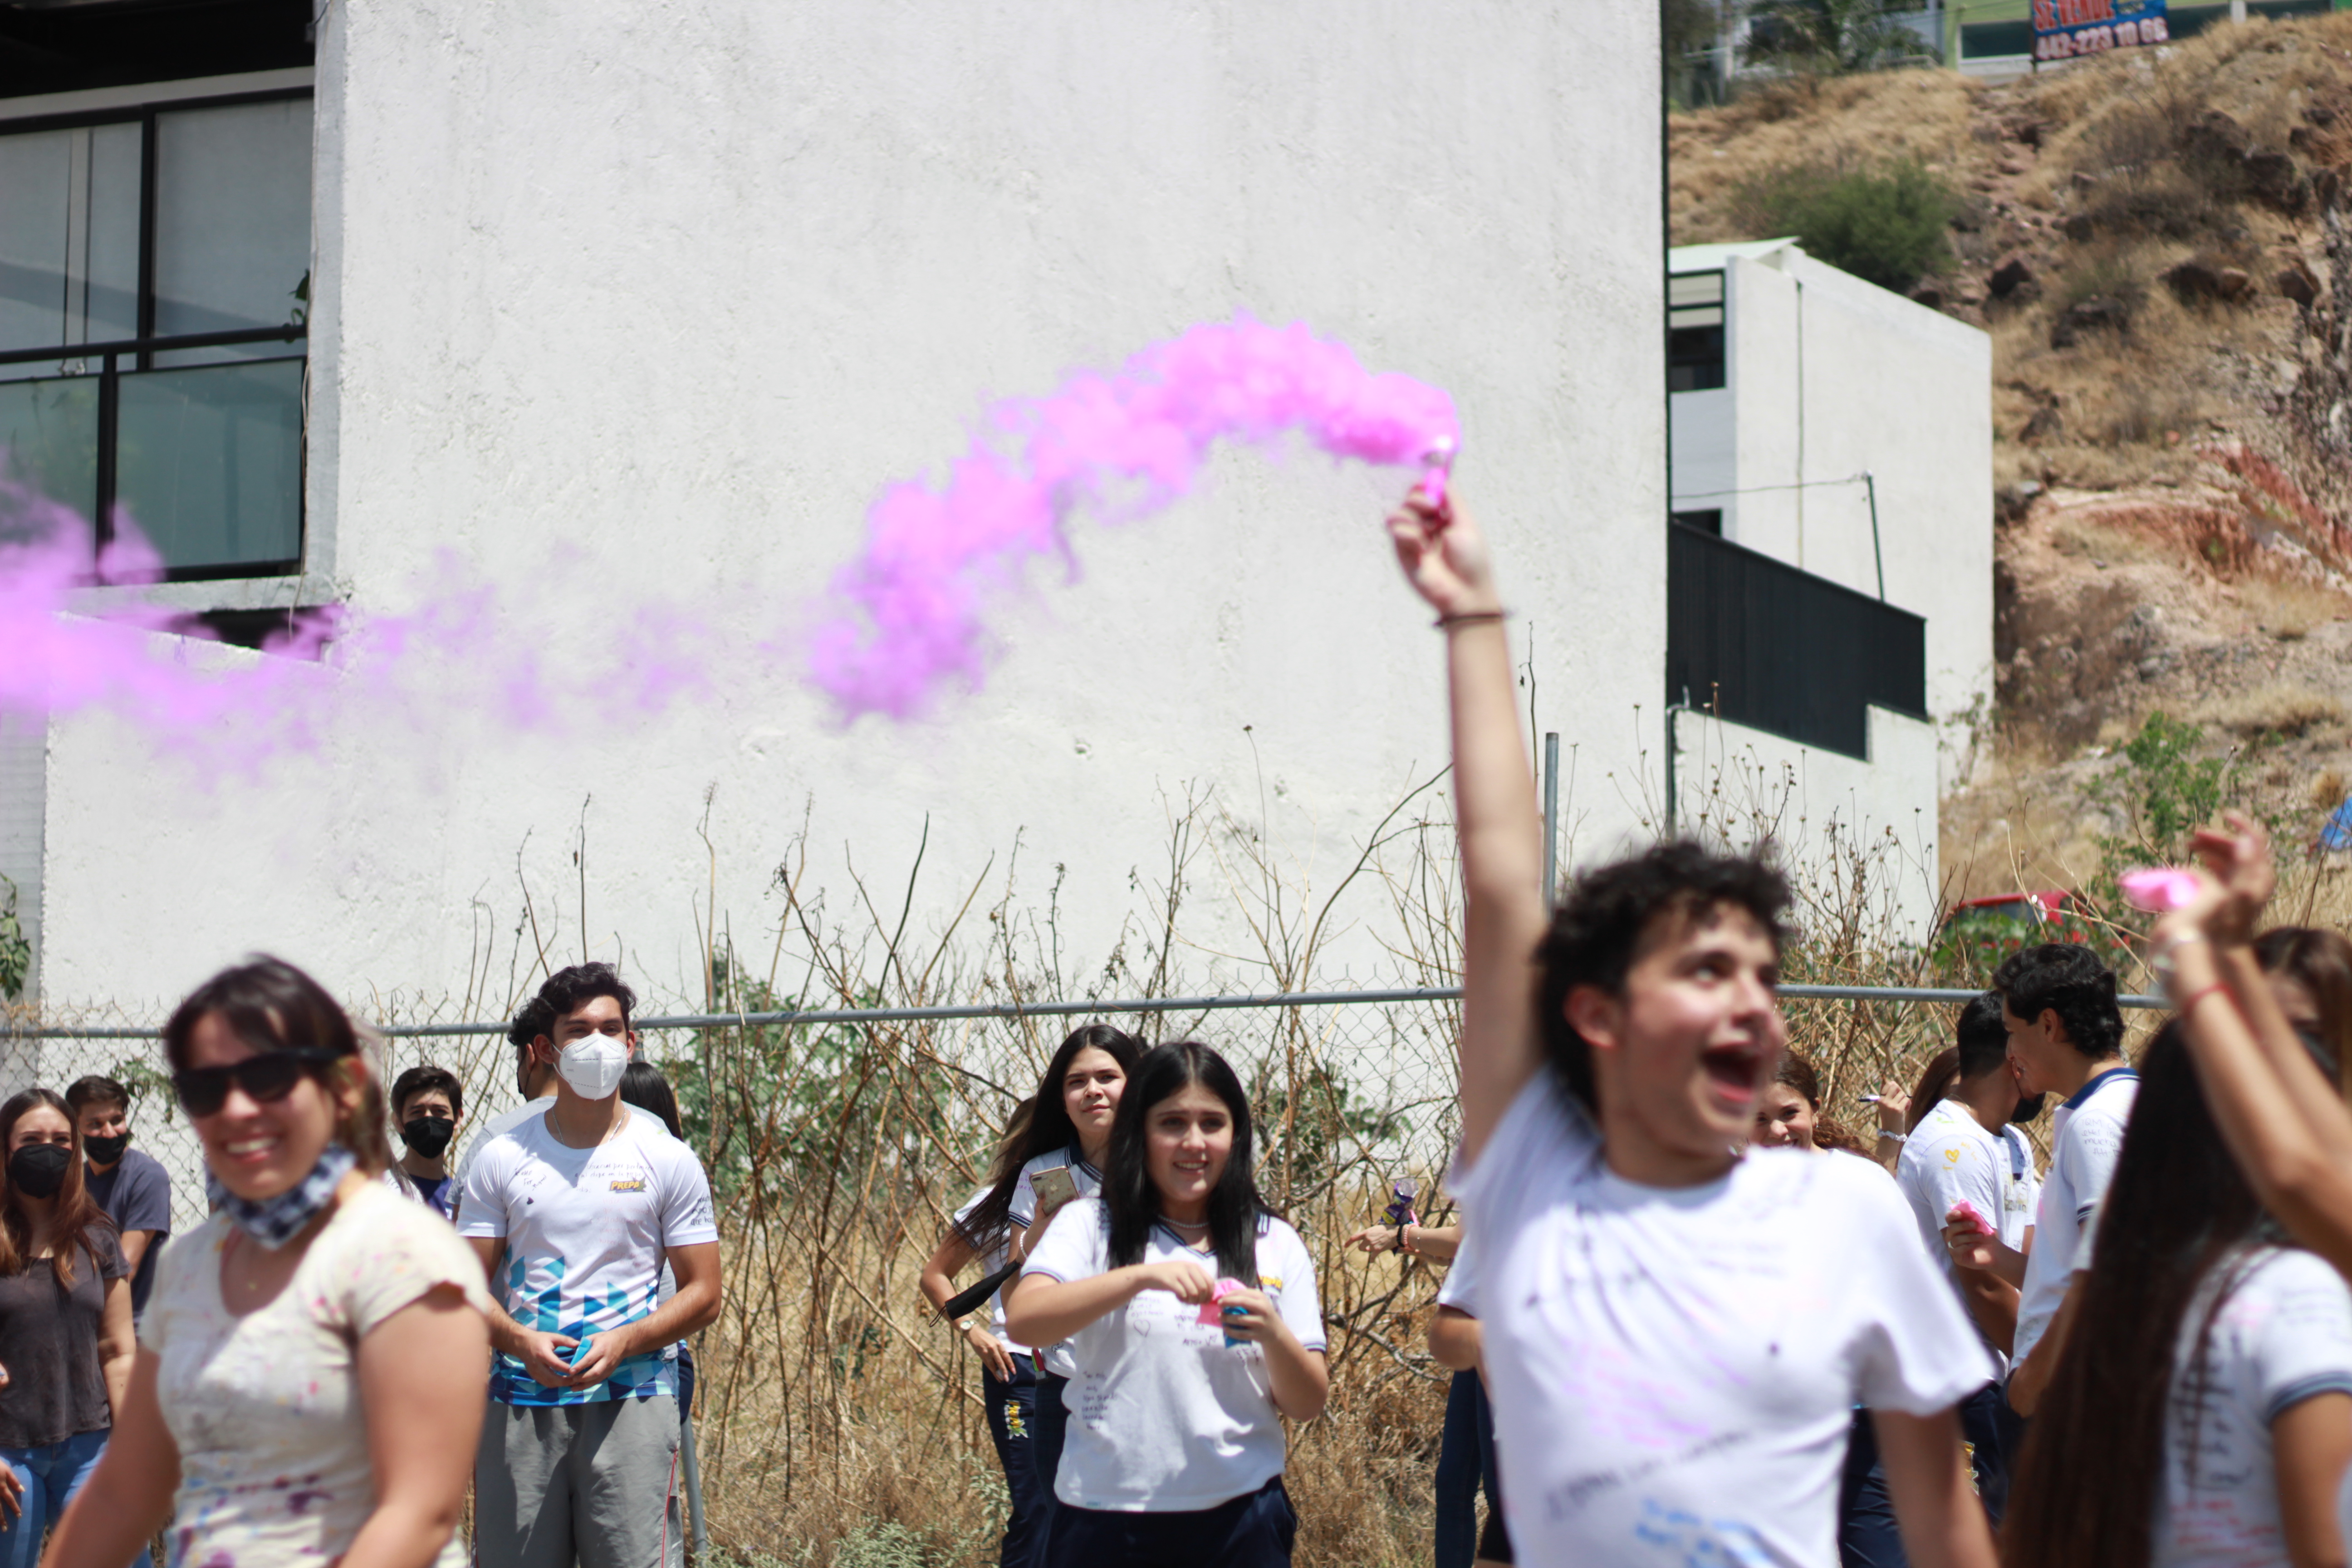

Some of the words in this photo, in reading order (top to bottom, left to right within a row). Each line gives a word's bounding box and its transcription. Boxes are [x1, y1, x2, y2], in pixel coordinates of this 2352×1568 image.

[2033, 0, 2058, 32] SE
[2035, 25, 2114, 61] 442-223
[2113, 21, 2139, 46] 10
[610, 1181, 640, 1191] PREPA
